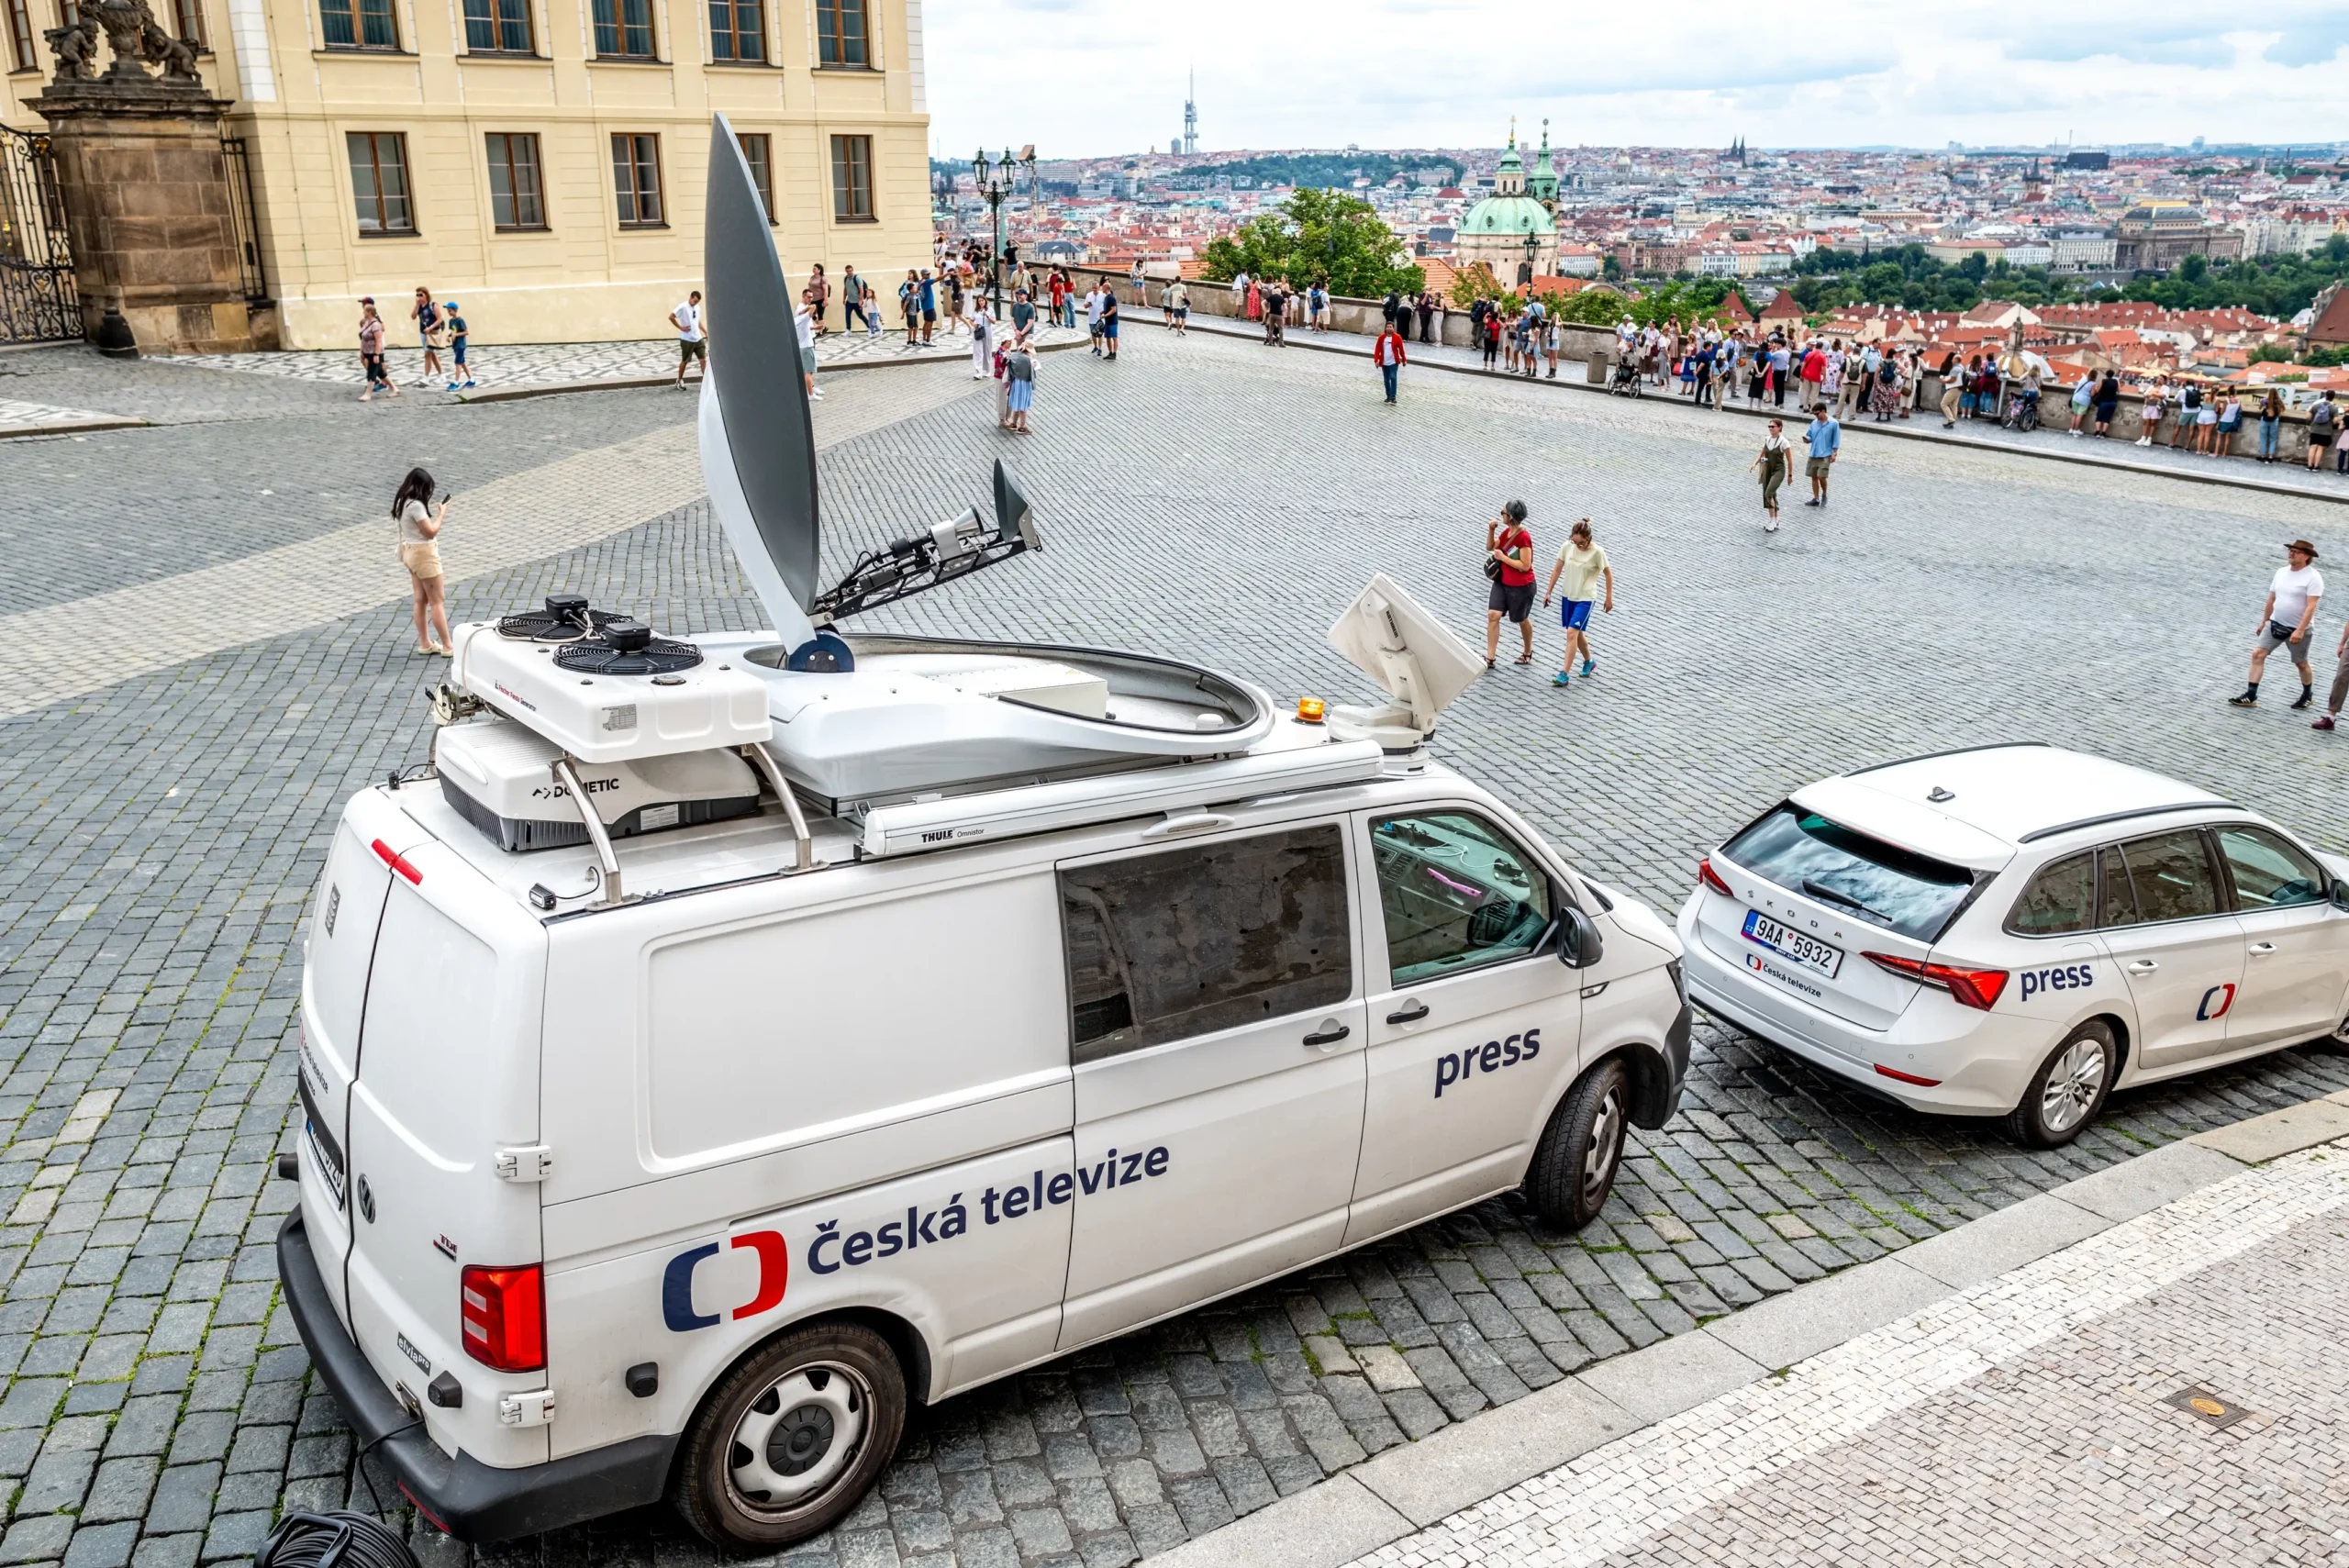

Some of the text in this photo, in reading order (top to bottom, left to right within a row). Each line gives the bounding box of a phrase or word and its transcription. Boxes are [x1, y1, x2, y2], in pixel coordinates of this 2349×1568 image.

[554, 778, 619, 798] DETIC
[921, 828, 985, 843] THULE Omnistor
[1756, 919, 1832, 969] 9AA 5932
[1763, 963, 1787, 982] Česká
[1787, 977, 1821, 998] televize
[2021, 964, 2093, 1002] press
[1434, 1029, 1541, 1099] press
[807, 1145, 1170, 1275] Česká televize
[440, 1232, 457, 1254] TDI
